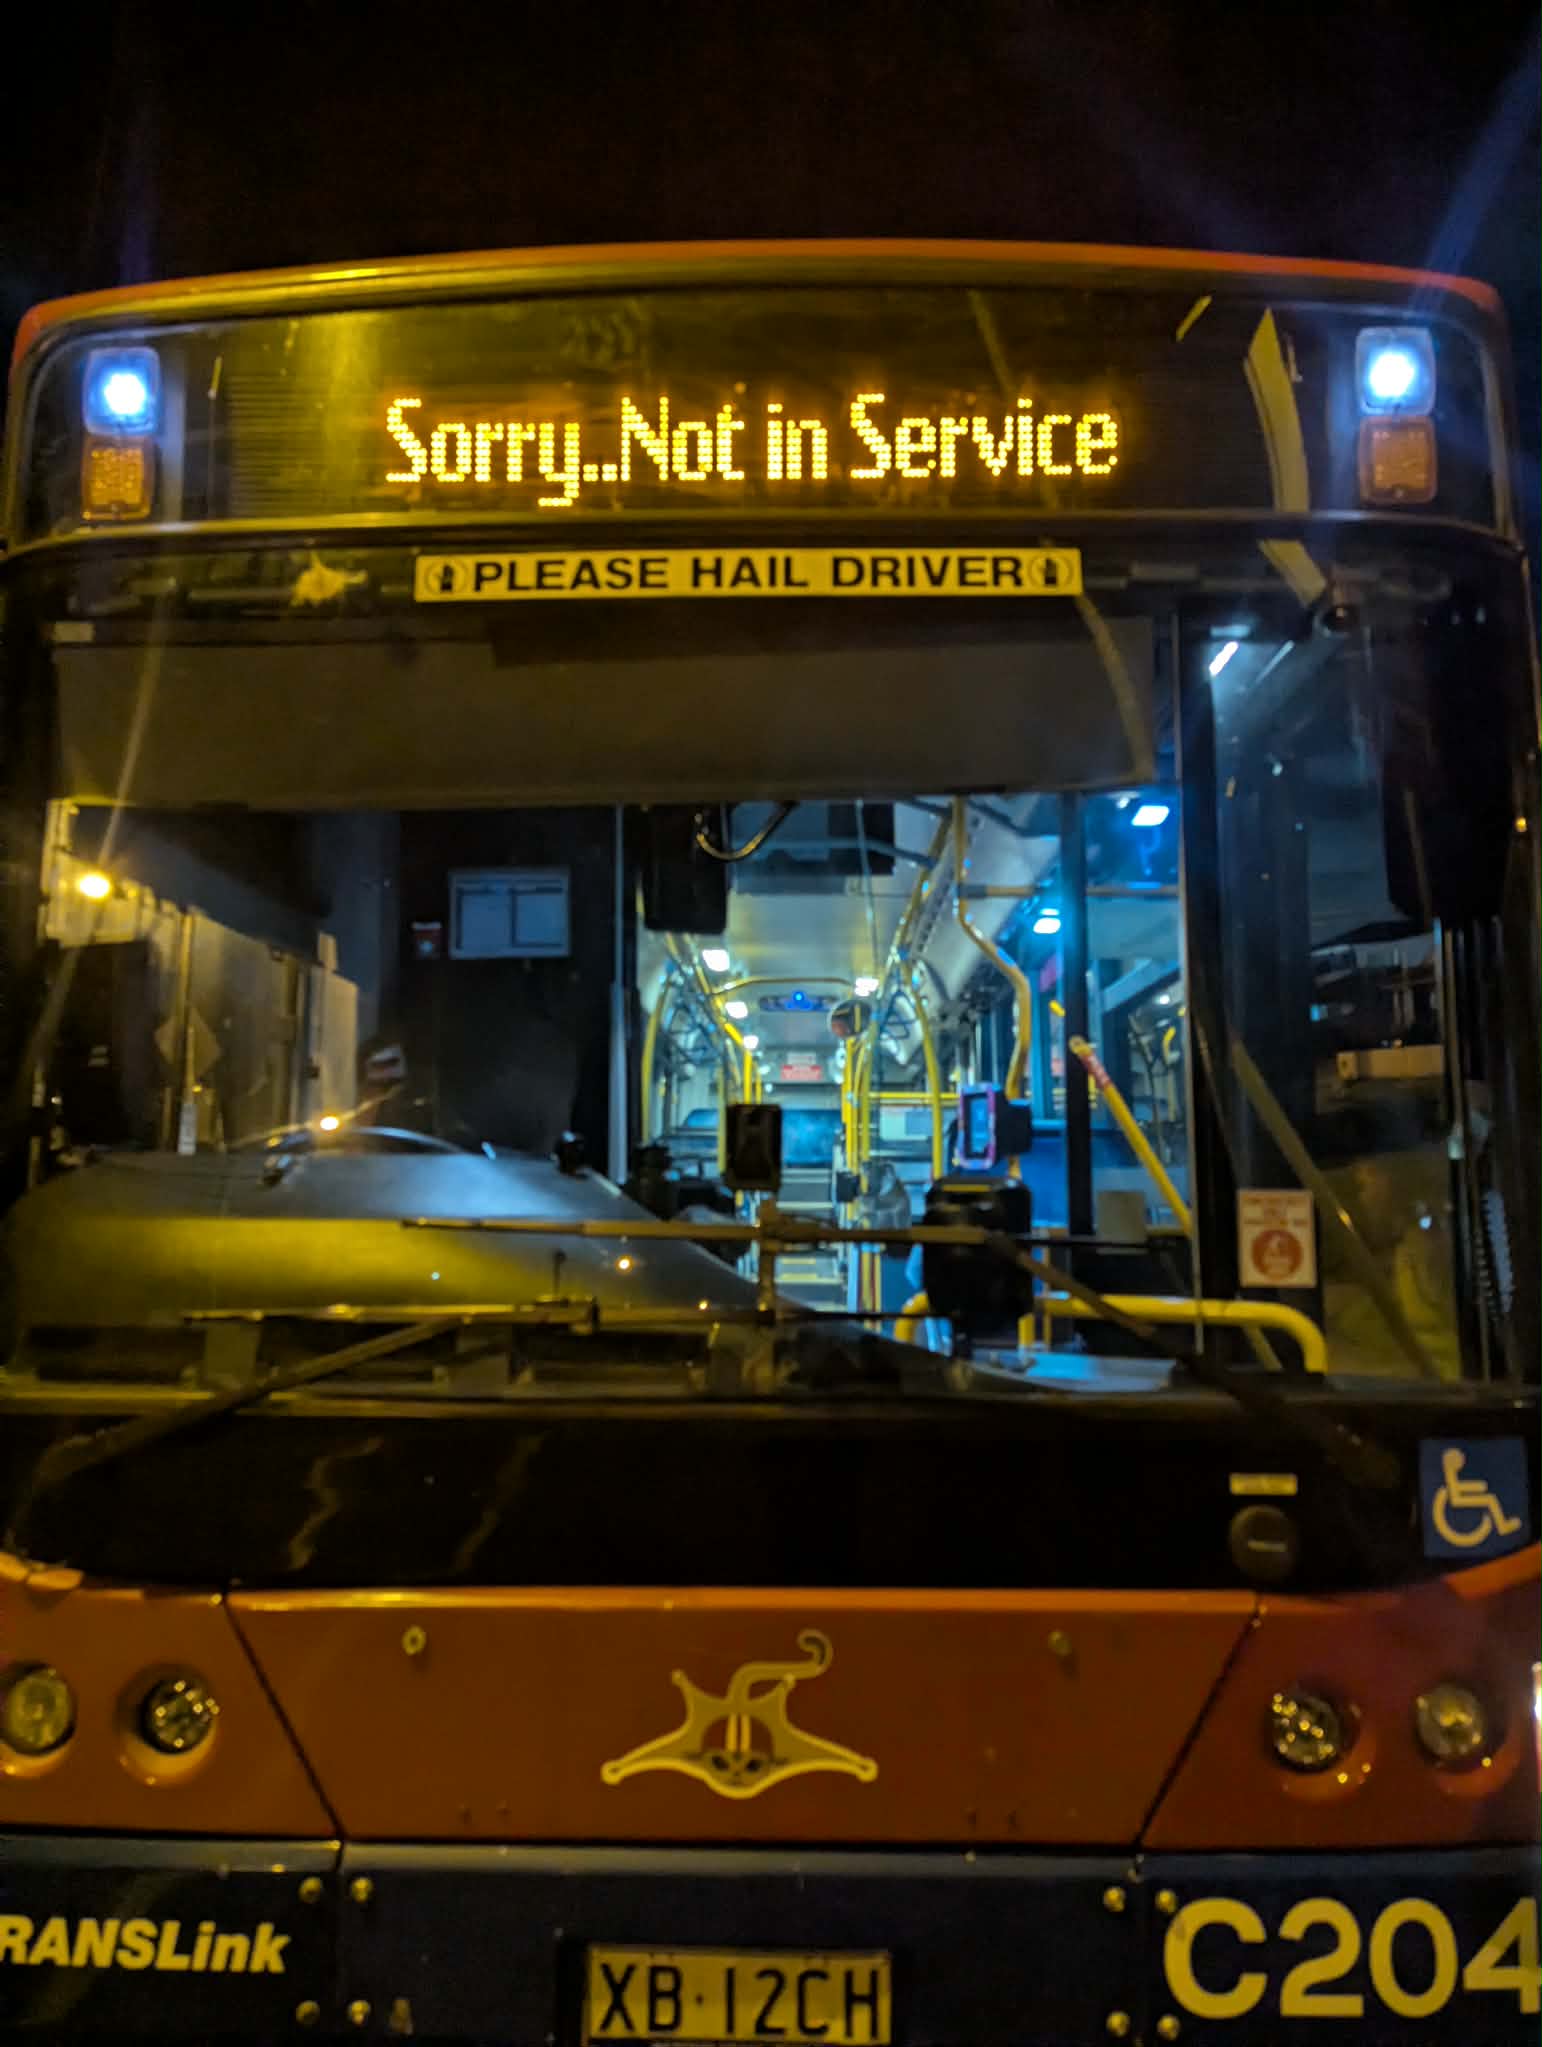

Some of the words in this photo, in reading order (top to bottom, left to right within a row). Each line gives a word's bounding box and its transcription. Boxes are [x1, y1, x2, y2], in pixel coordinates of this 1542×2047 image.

[767, 403, 828, 480] in
[850, 393, 1119, 479] Service
[473, 557, 670, 593] PLEASE
[690, 555, 809, 589] HAIL
[831, 555, 1023, 588] DRIVER
[1163, 1897, 1542, 2020] C204
